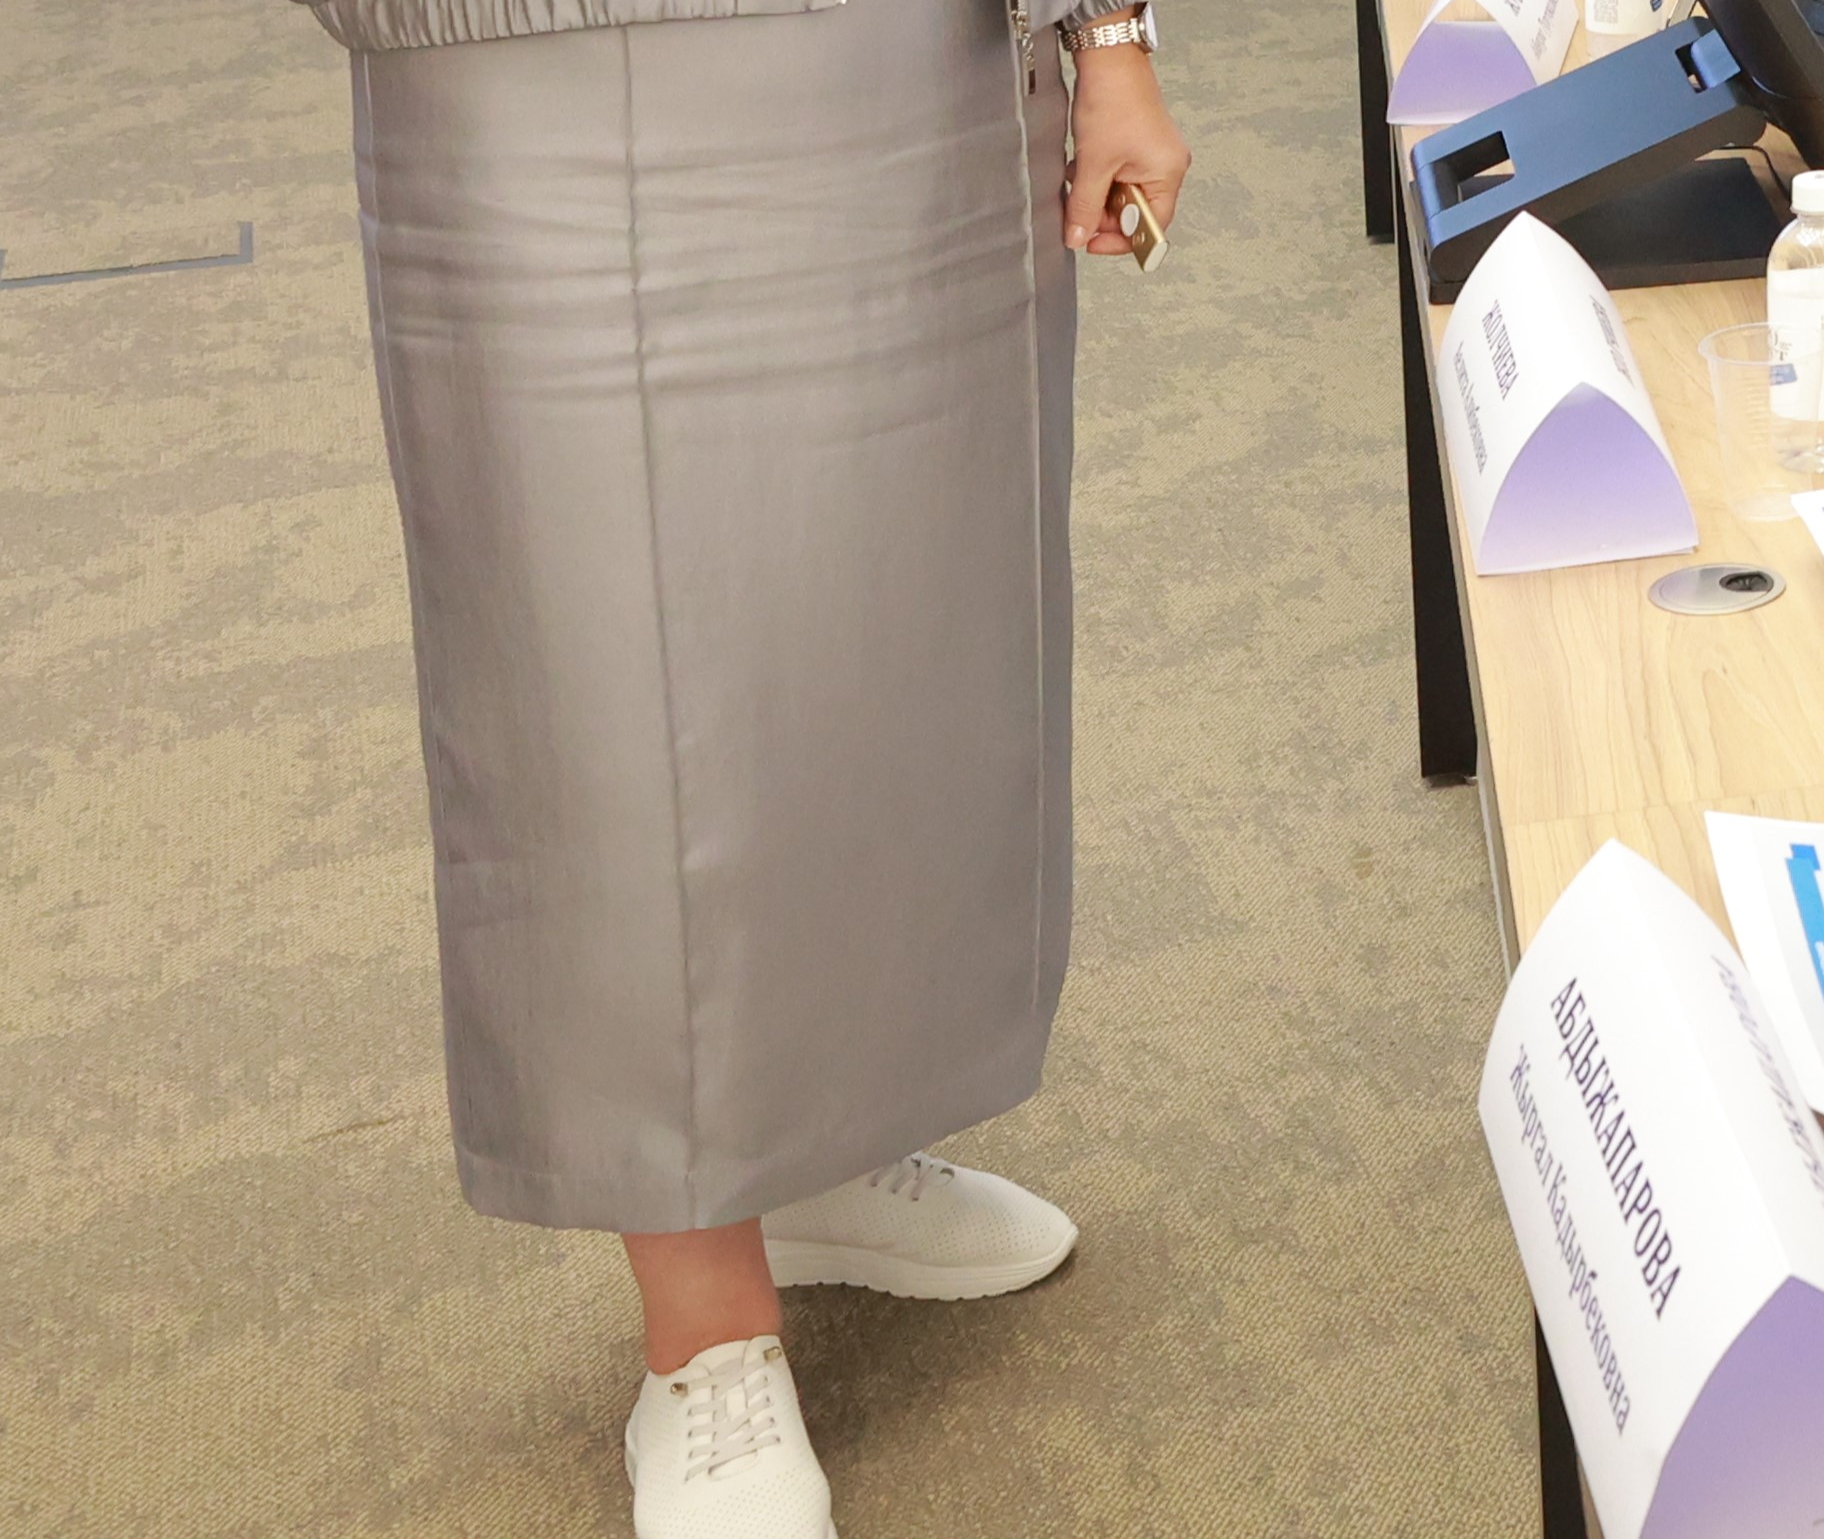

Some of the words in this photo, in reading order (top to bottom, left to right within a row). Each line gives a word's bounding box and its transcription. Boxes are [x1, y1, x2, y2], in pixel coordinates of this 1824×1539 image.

[1482, 300, 1518, 399] ЖОЛЧИЕВА
[1508, 1043, 1554, 1187] Жыргал
[1545, 1164, 1632, 1437] Кадырбековна
[1550, 977, 1682, 1320] АБДЫЖАПАРОВА
